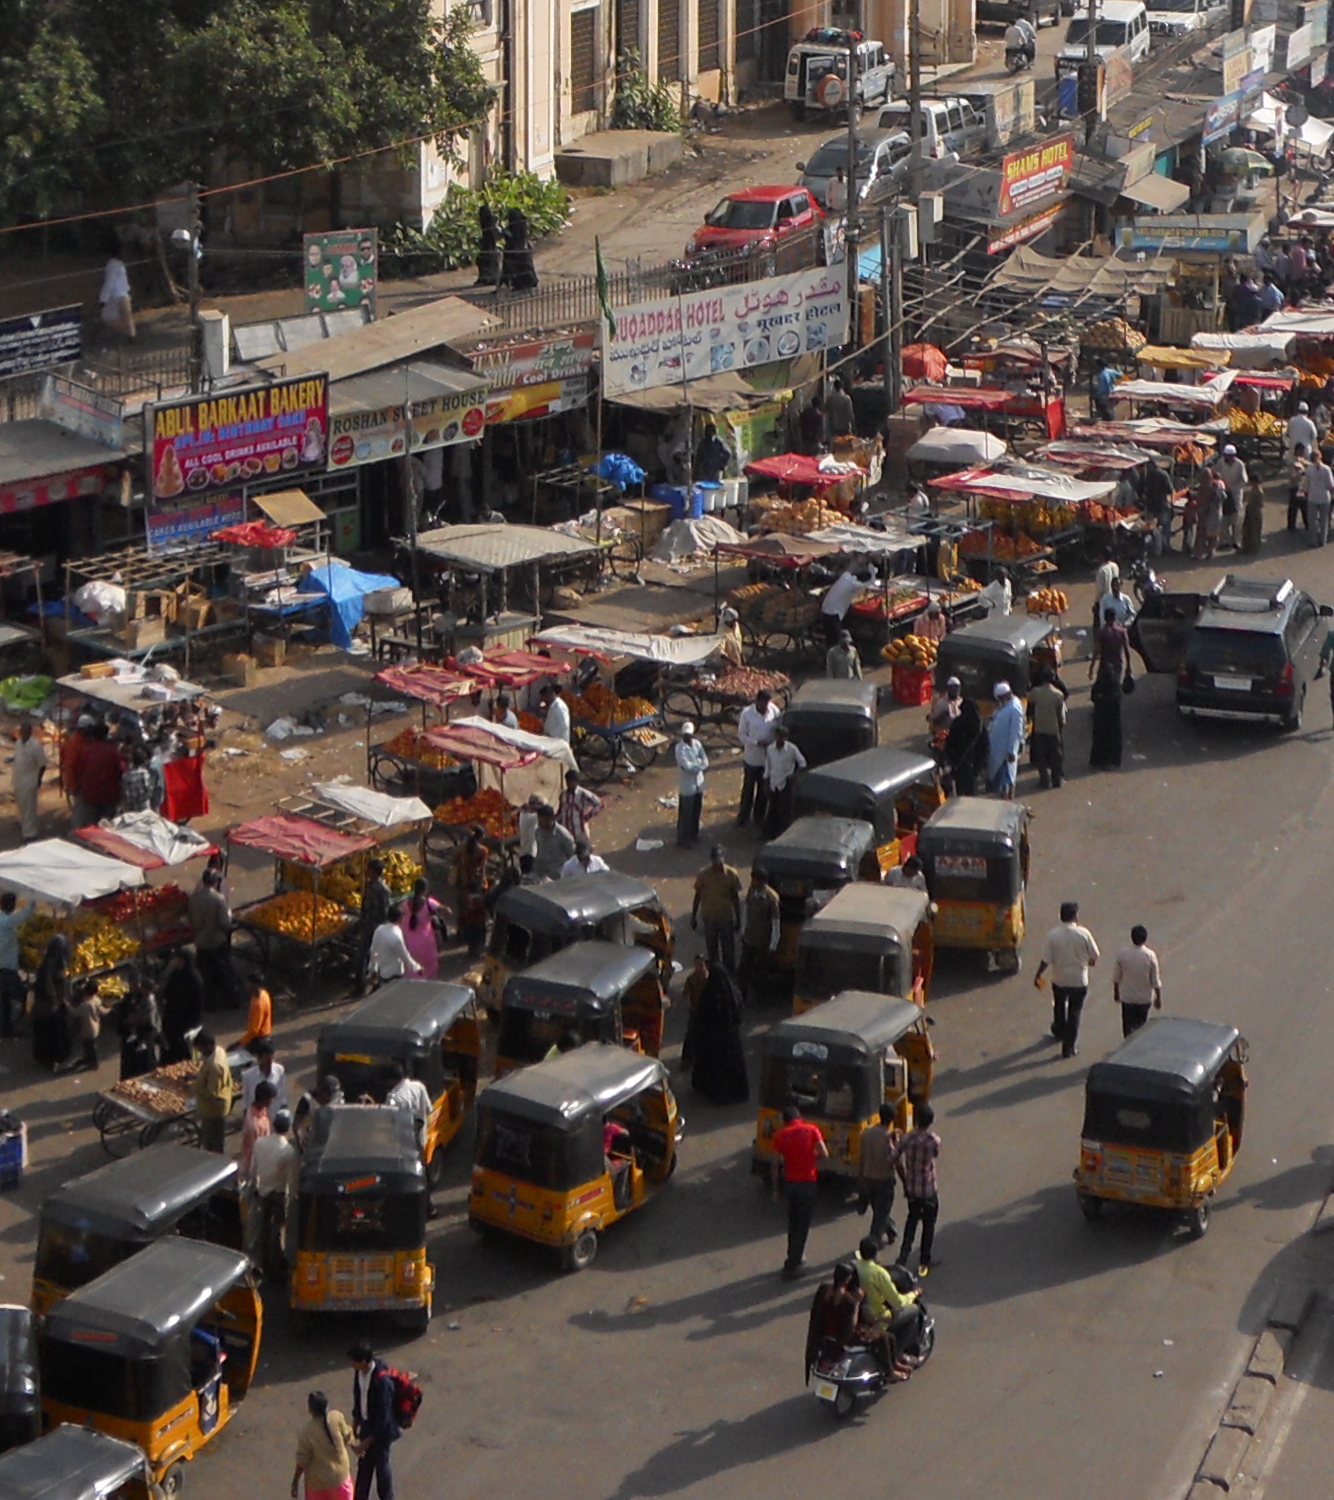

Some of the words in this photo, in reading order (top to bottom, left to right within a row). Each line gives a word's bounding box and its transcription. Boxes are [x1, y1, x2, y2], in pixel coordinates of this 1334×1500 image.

[1006, 152, 1040, 182] SHAMS
[1041, 141, 1069, 168] HOTEL
[686, 297, 725, 329] HOTEL
[523, 372, 547, 384] Cool
[552, 365, 588, 379] Drinks
[156, 406, 194, 439] ABUL
[198, 391, 267, 430] BARKAAT
[270, 378, 325, 415] BAKERY
[333, 411, 387, 435] ROSHAN
[442, 389, 485, 412] HOUSE
[184, 457, 200, 469] ALL
[201, 452, 223, 465] COOL
[225, 445, 254, 460] DRINKS
[256, 435, 298, 454] AVAILABLE
